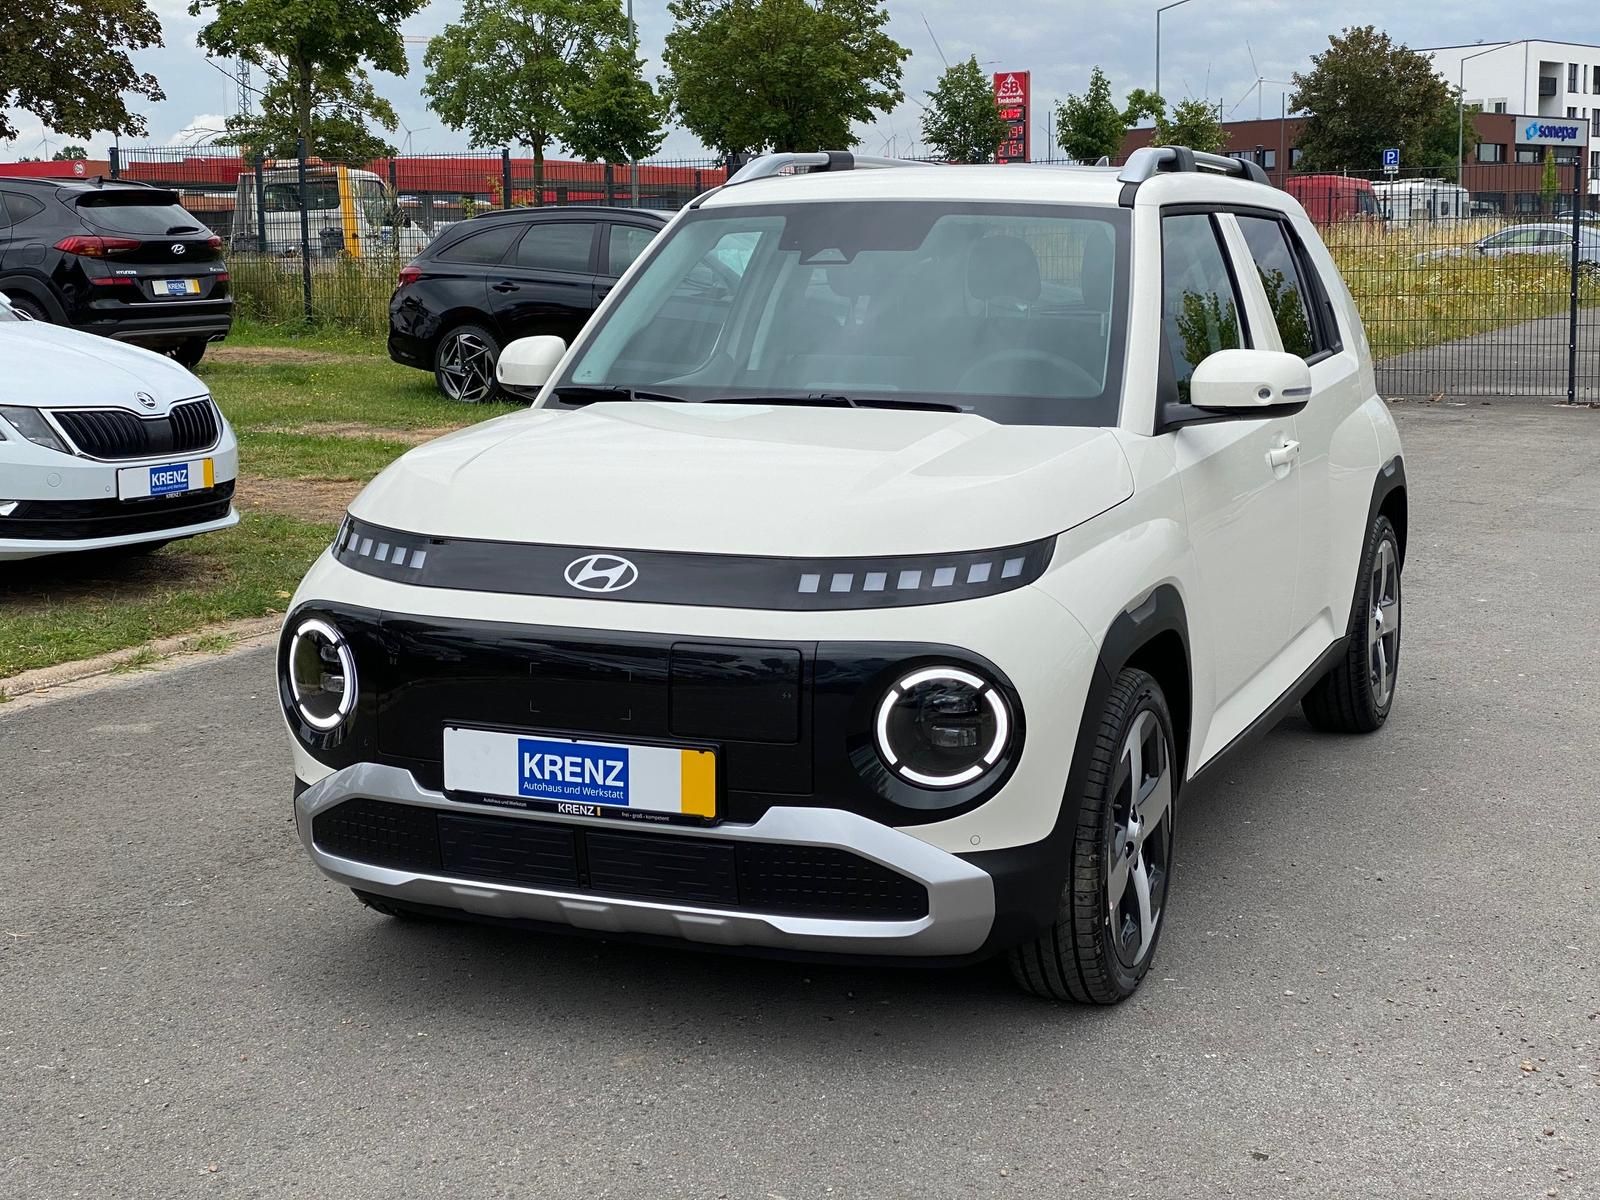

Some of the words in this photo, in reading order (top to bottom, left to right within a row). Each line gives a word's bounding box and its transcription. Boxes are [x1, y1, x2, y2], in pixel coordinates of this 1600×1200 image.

[1002, 81, 1019, 94] SB
[1538, 125, 1578, 141] sonepar
[1387, 151, 1396, 163] P
[152, 470, 187, 486] KRENZ
[523, 752, 624, 787] KRENZ
[523, 781, 562, 794] Autohaus
[564, 786, 581, 795] und
[582, 787, 624, 800] Werkstatt
[557, 803, 595, 816] KRENZ
